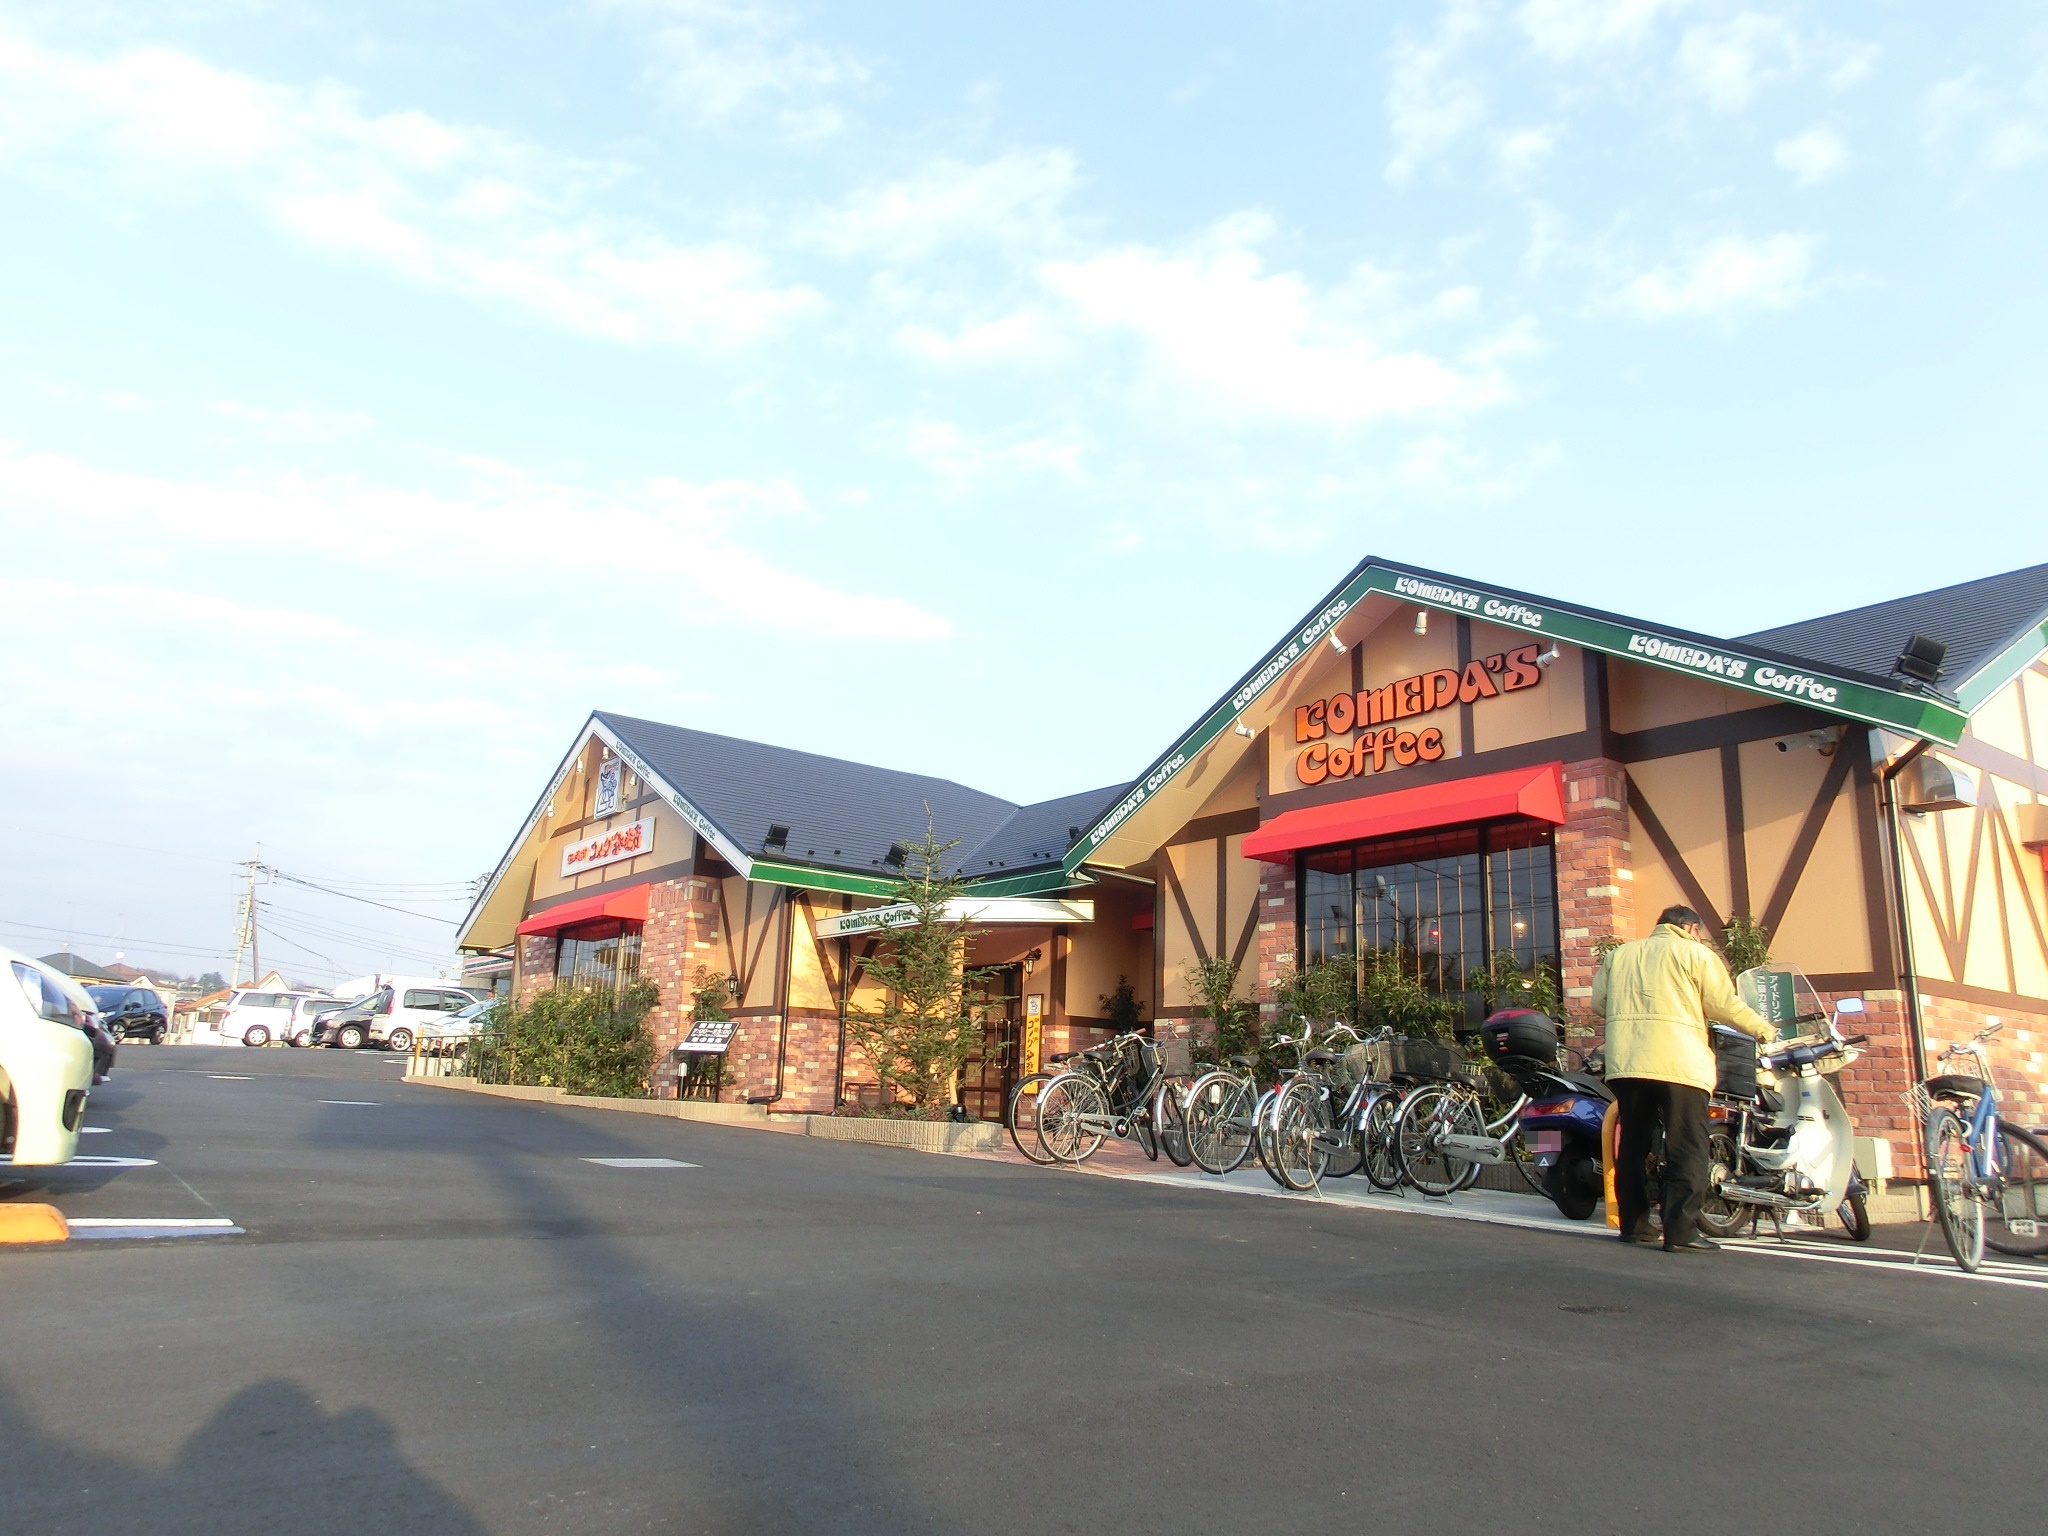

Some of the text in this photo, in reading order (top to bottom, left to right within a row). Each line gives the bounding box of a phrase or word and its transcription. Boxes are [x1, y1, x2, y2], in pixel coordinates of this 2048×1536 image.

[1394, 576, 1543, 628] KOMEDA'S Coffee
[1232, 600, 1348, 711] KOMEDA'S Coffee
[1295, 643, 1542, 743] KOMEDA'S
[1628, 634, 1838, 703] KOMEDA'S Coffee
[1296, 726, 1445, 785] Coffee
[1089, 753, 1186, 846] KOMEDA'S Coffee
